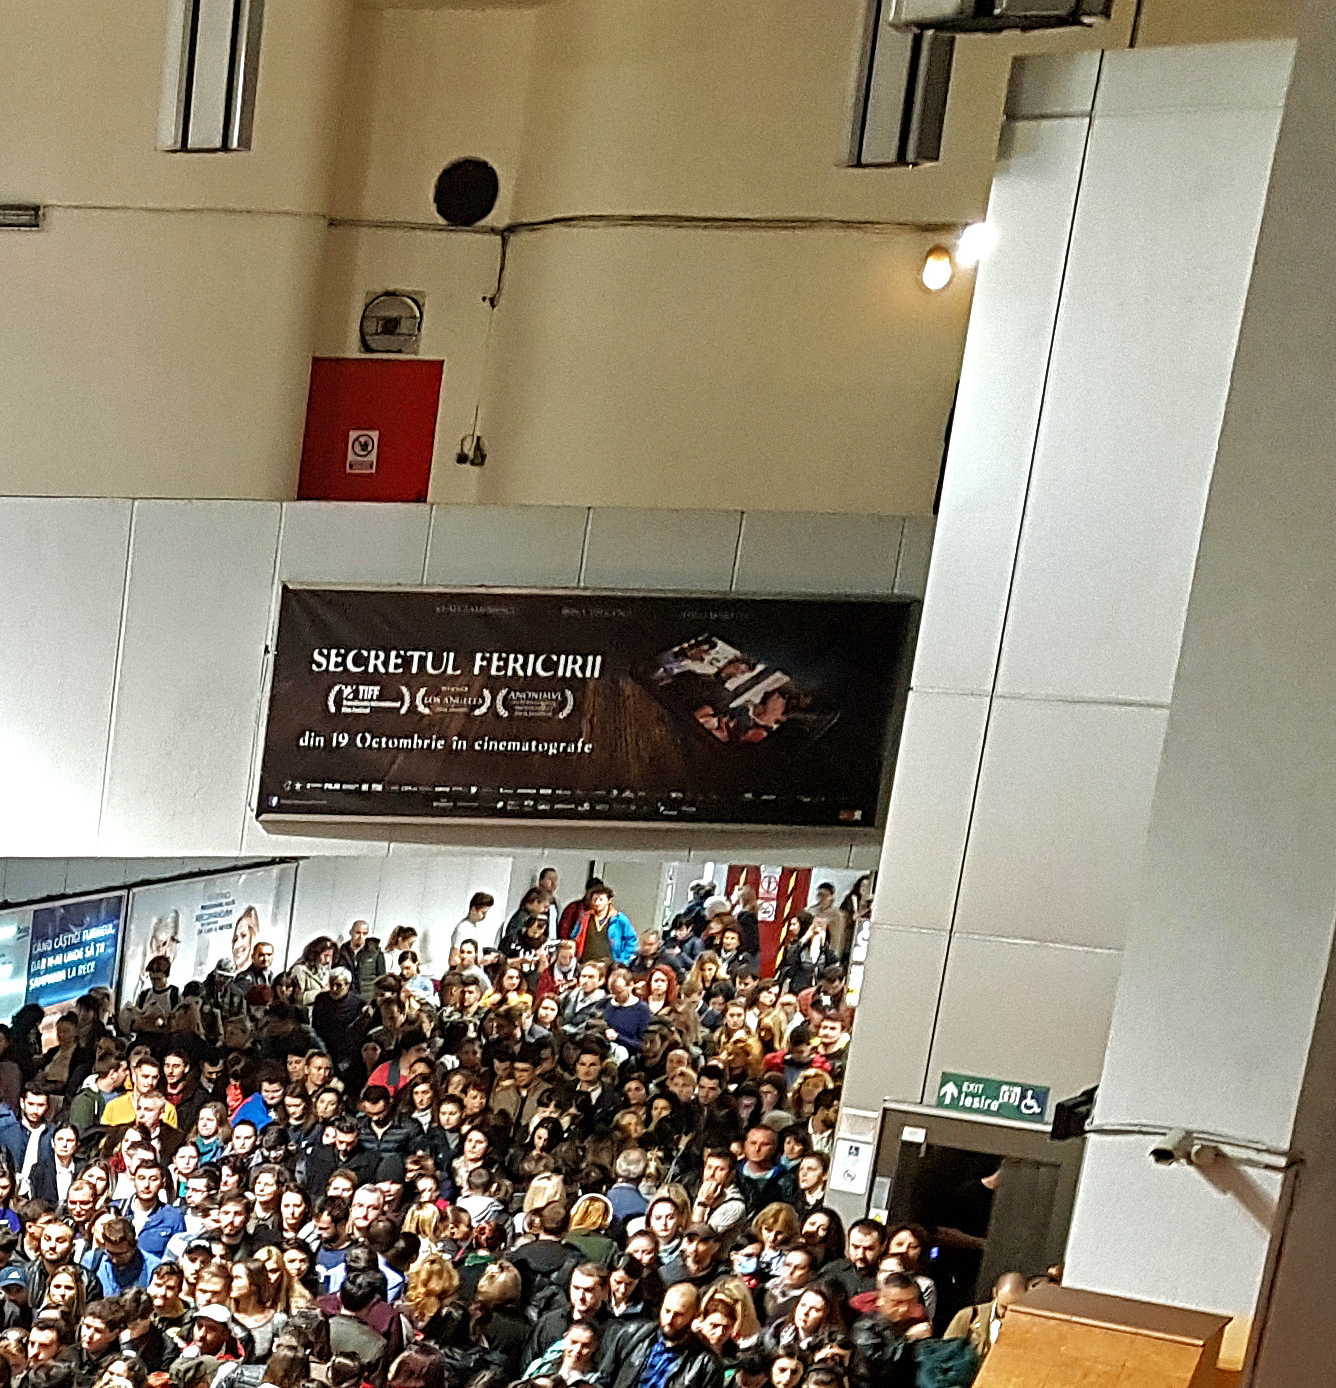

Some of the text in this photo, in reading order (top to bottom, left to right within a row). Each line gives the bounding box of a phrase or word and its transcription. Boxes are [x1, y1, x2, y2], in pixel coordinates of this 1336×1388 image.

[311, 648, 603, 679] SECRETUL FERICIRII
[299, 730, 325, 748] din
[332, 732, 349, 748] 19
[355, 732, 446, 750] Octombrie
[474, 736, 593, 756] cinematografe
[67, 966, 77, 979] LA
[77, 961, 96, 977] RECE
[962, 1081, 985, 1094] EXIT
